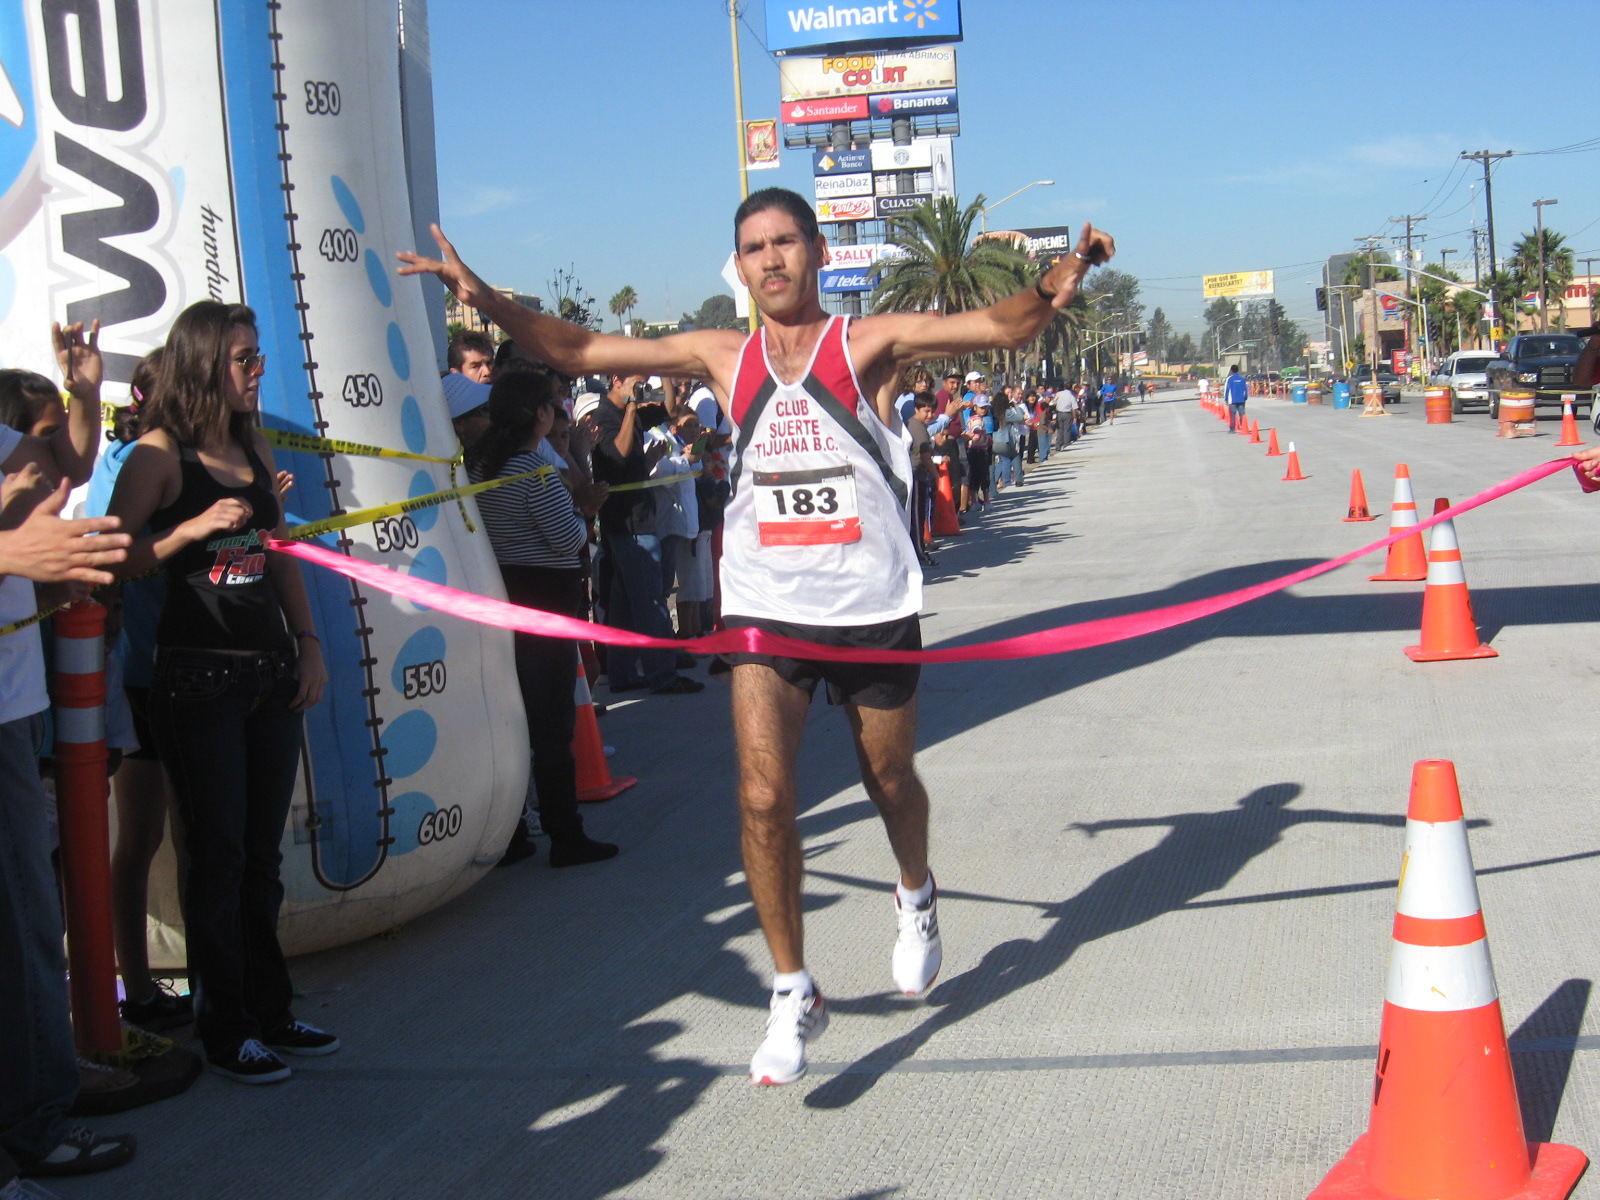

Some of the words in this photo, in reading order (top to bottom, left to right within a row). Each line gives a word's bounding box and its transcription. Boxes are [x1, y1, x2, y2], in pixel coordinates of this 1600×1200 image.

[787, 1, 899, 33] Walmart
[822, 55, 877, 75] FOOD
[842, 66, 908, 87] COURT
[304, 81, 341, 115] 350
[806, 103, 859, 117] Santander
[893, 95, 949, 110] Banamex
[841, 161, 863, 169] Banco
[200, 203, 230, 303] mpany
[320, 229, 358, 262] 400
[835, 248, 873, 261] SALLY
[343, 373, 383, 407] 450
[776, 399, 809, 417] CLUB
[769, 419, 820, 439] SUERTE
[755, 438, 809, 458] TIJUANA
[814, 436, 839, 451] B.C.
[772, 487, 839, 515] 183
[373, 515, 418, 551] 500
[403, 660, 446, 699] 550
[418, 804, 462, 845] 600
